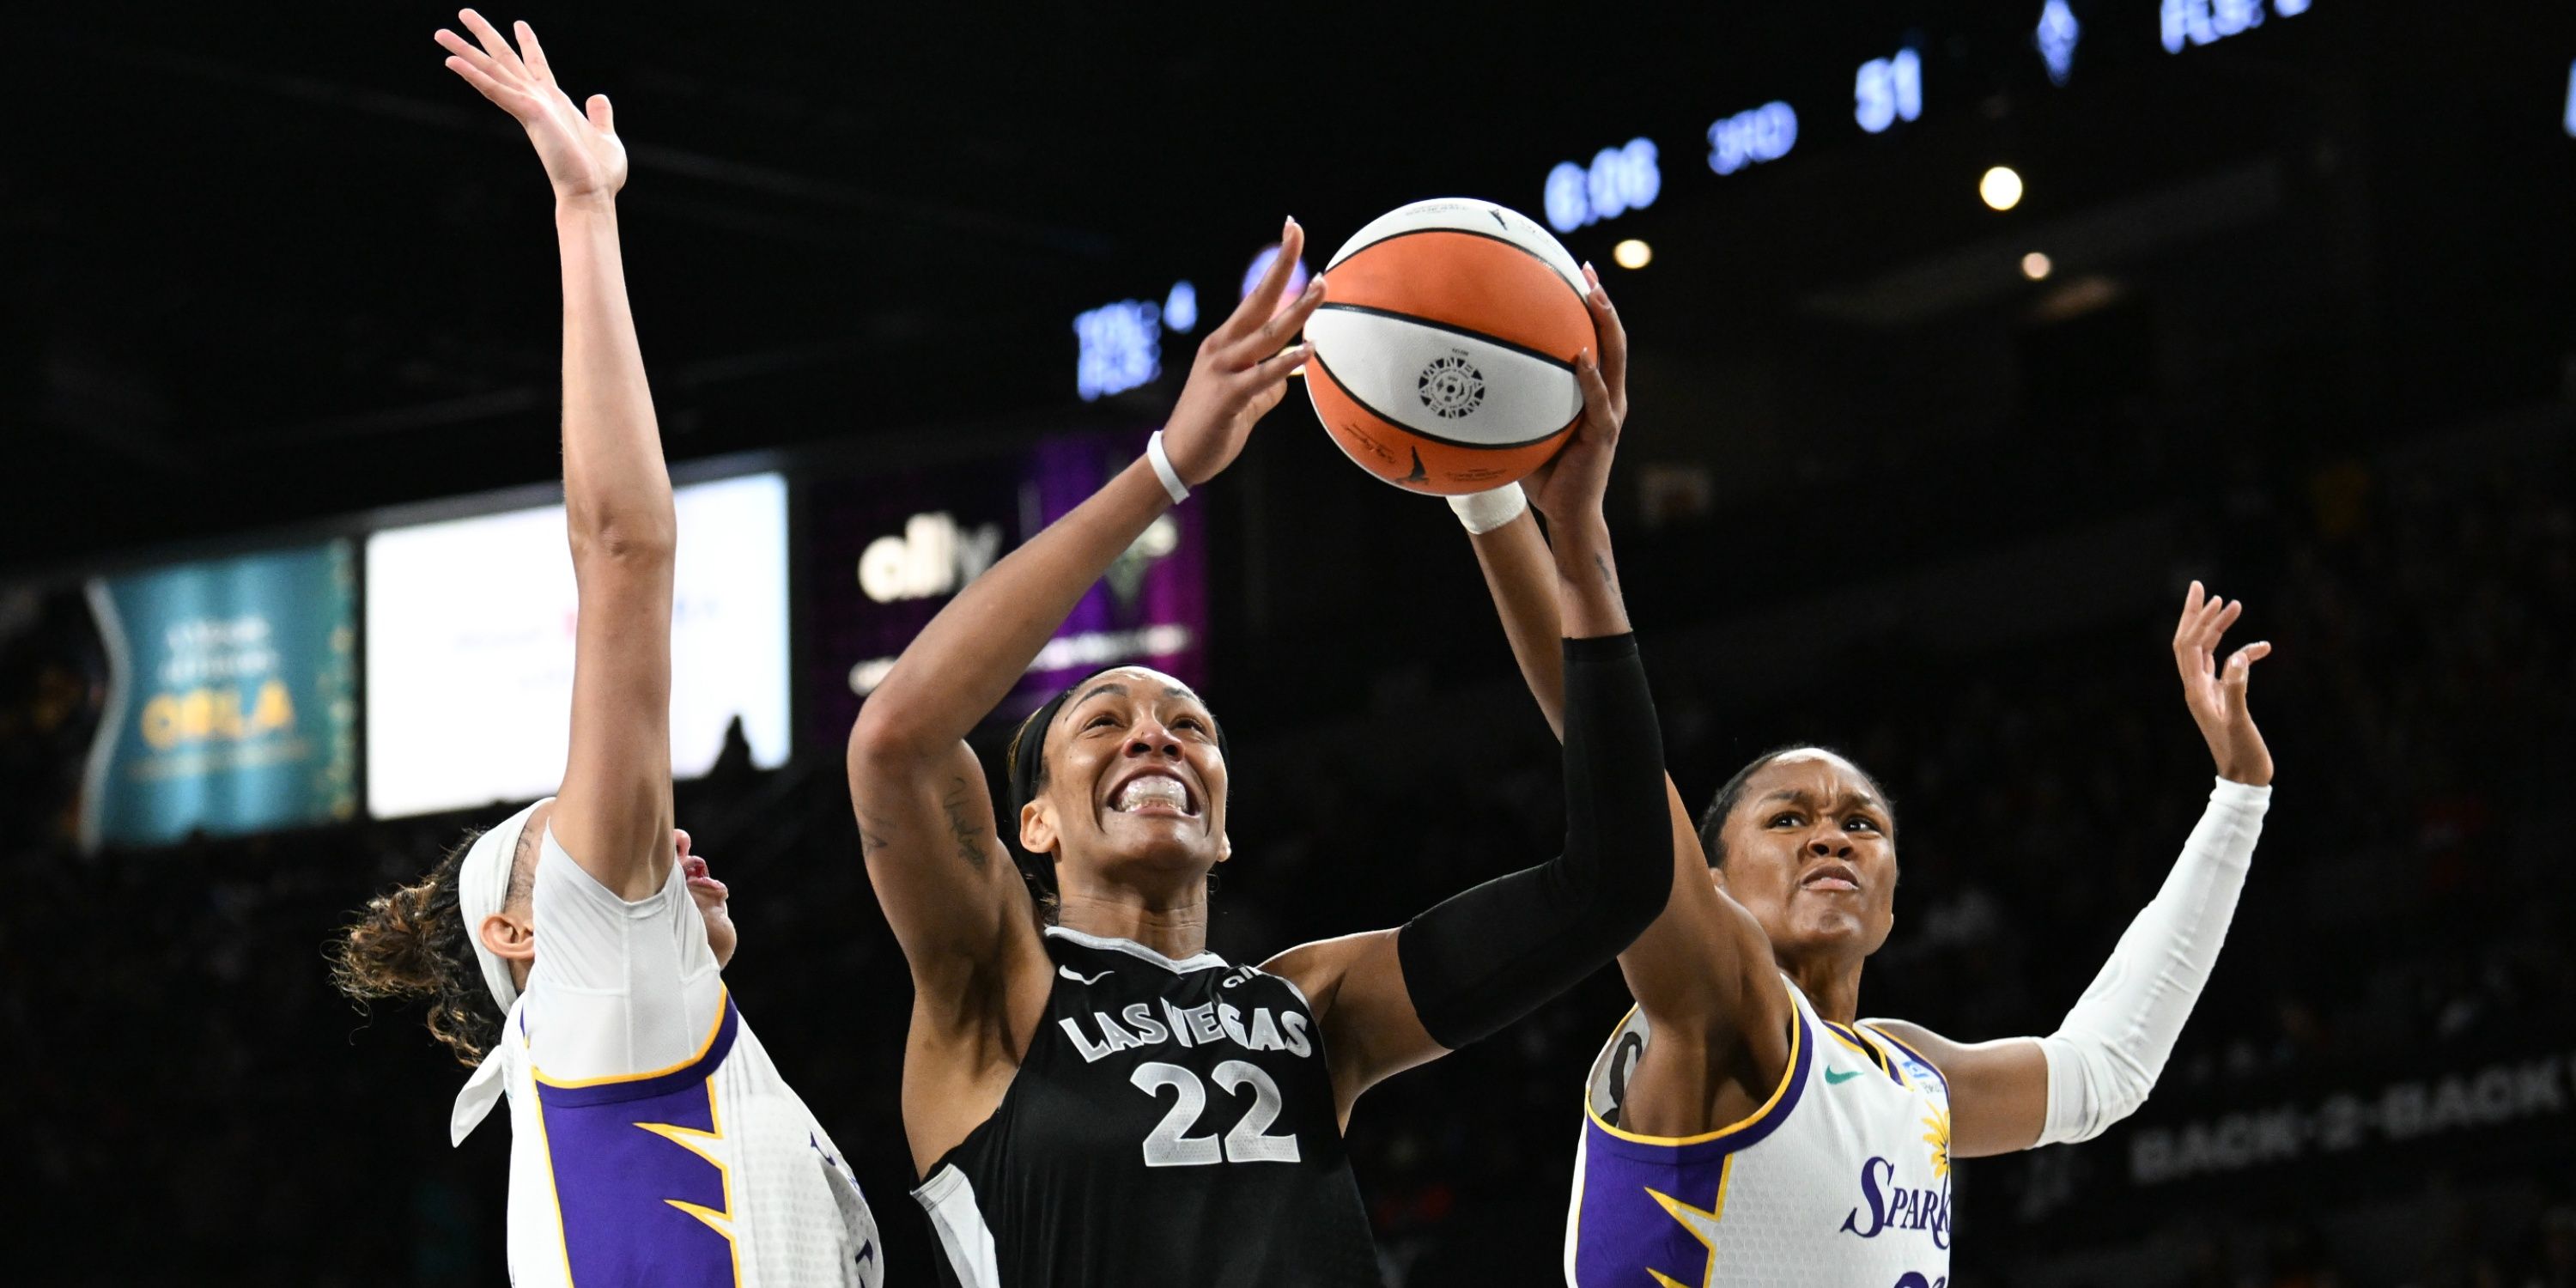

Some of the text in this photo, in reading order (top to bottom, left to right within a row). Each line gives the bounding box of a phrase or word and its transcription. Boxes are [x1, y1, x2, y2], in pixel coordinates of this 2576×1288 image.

[1855, 47, 1922, 133] 51
[1059, 997, 1312, 1063] LAS VEGAS
[1130, 1060, 1301, 1167] 22
